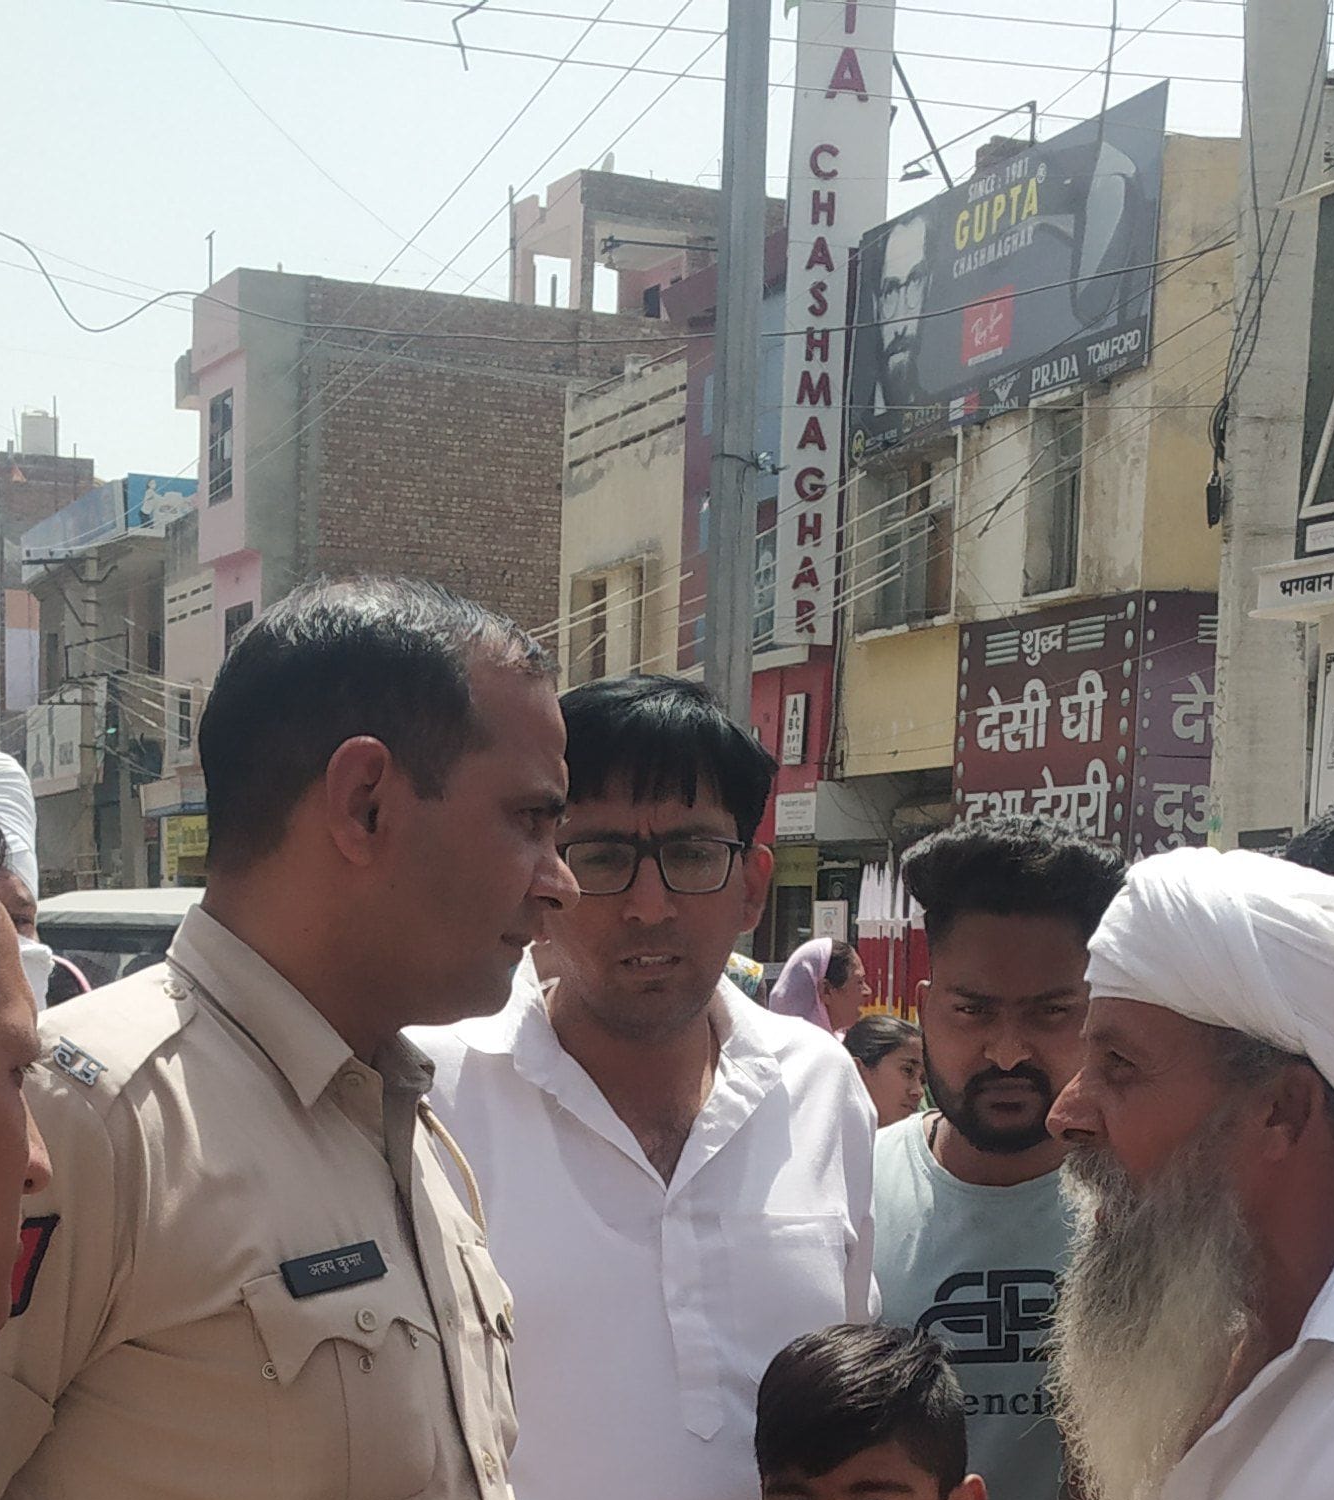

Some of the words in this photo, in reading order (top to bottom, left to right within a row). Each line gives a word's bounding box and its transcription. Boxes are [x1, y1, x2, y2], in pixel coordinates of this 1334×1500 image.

[955, 177, 1039, 251] GUPTA
[953, 224, 1035, 279] CHASHMAGHAR
[1087, 338, 1110, 366] TOM
[1110, 328, 1141, 358] FORD
[793, 144, 841, 635] CHASHMAGHAR
[1031, 353, 1079, 391] PRADA
[1279, 571, 1334, 597] भगवान
[1021, 623, 1066, 666] शुद्ध
[976, 678, 1051, 752] देसी
[1059, 669, 1108, 743] घी
[307, 1259, 337, 1277] अजय
[334, 1252, 365, 1274] कुमार
